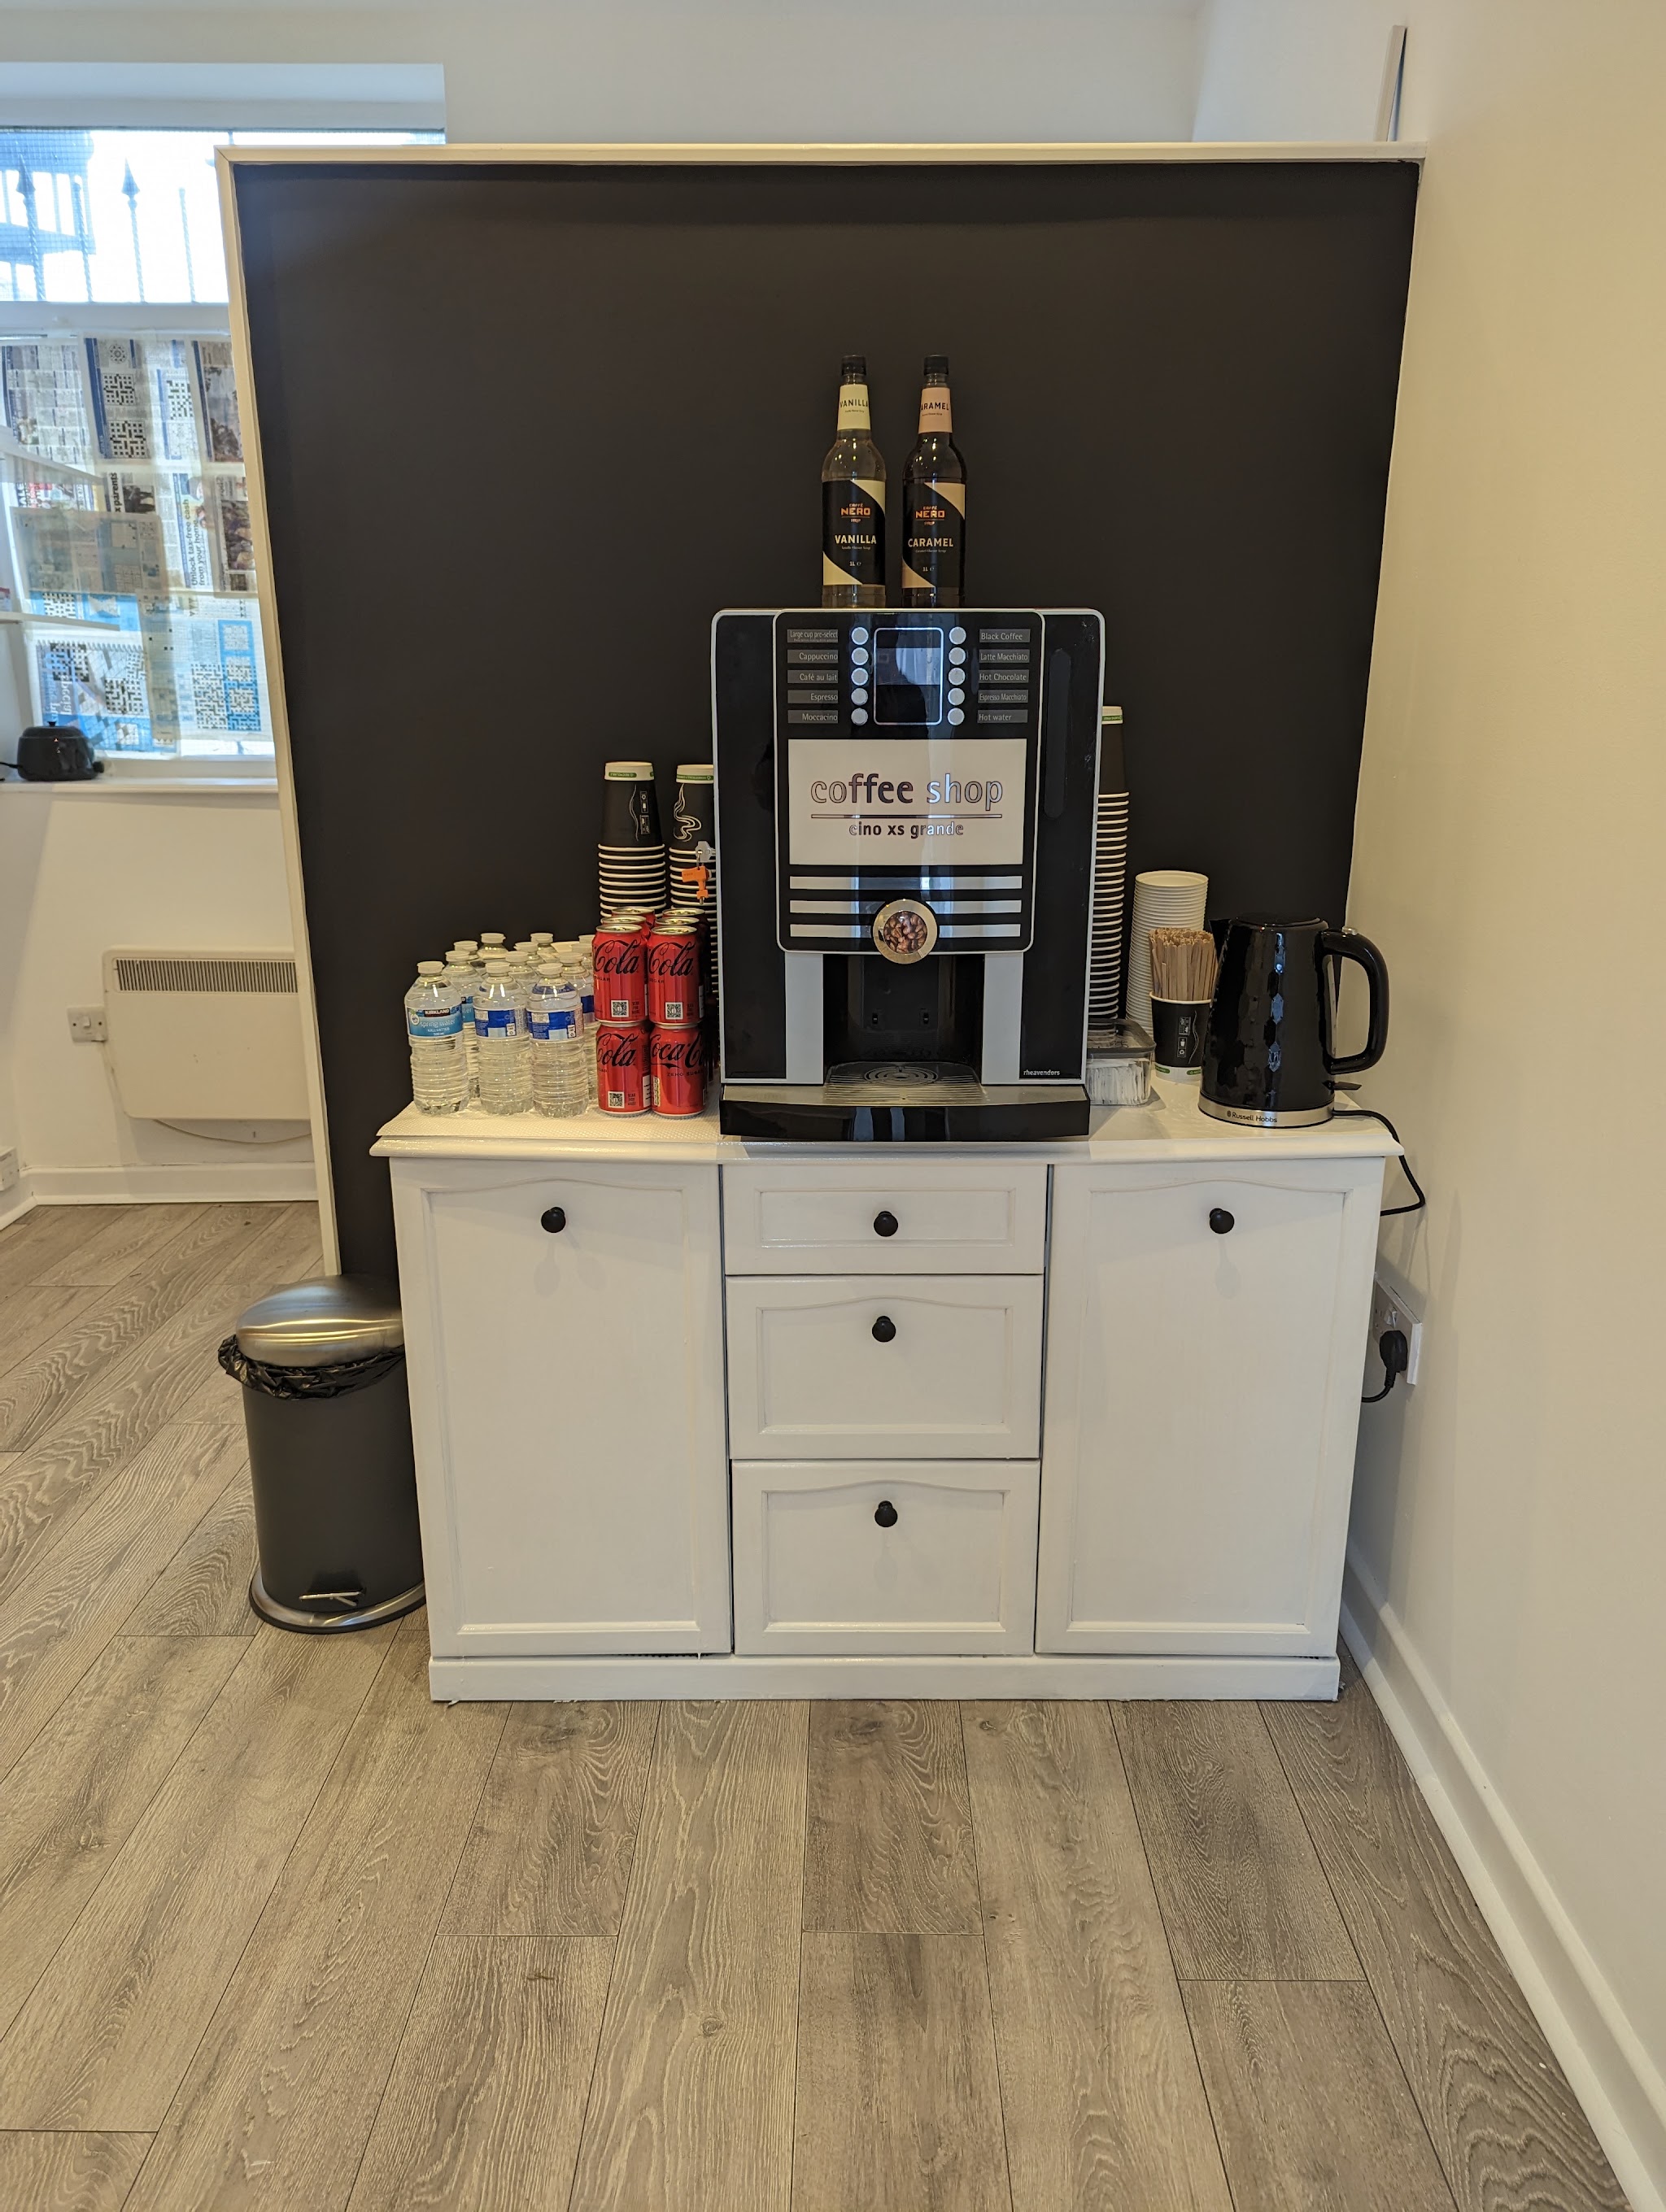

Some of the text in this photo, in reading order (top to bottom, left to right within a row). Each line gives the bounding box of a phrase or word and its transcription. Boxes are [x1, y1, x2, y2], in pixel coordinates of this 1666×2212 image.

[840, 398, 869, 408] VANILLA
[921, 402, 949, 411] ARAMEL
[111, 472, 122, 506] parents
[840, 507, 871, 516] NERO
[915, 510, 945, 519] NERO
[183, 499, 198, 586] Unlock tax-free cash
[835, 534, 877, 544] VANILLA
[908, 538, 954, 547] CARAMEL
[195, 545, 204, 564] your
[790, 630, 804, 639] Large
[813, 629, 838, 639] pre-select
[981, 632, 1023, 641] Black Coffee
[799, 652, 838, 661] Cappuccino
[826, 673, 838, 681] lait
[979, 673, 1027, 681] Hot Chocolate
[810, 693, 838, 702] Espresso
[979, 693, 1027, 702] Espresso Macchiato
[802, 713, 838, 721] Moccacino
[979, 713, 991, 721] Hot
[811, 773, 1004, 812] coffee shop
[848, 821, 964, 839] cino xs grande
[1232, 1112, 1278, 1123] Russell Hobbs
